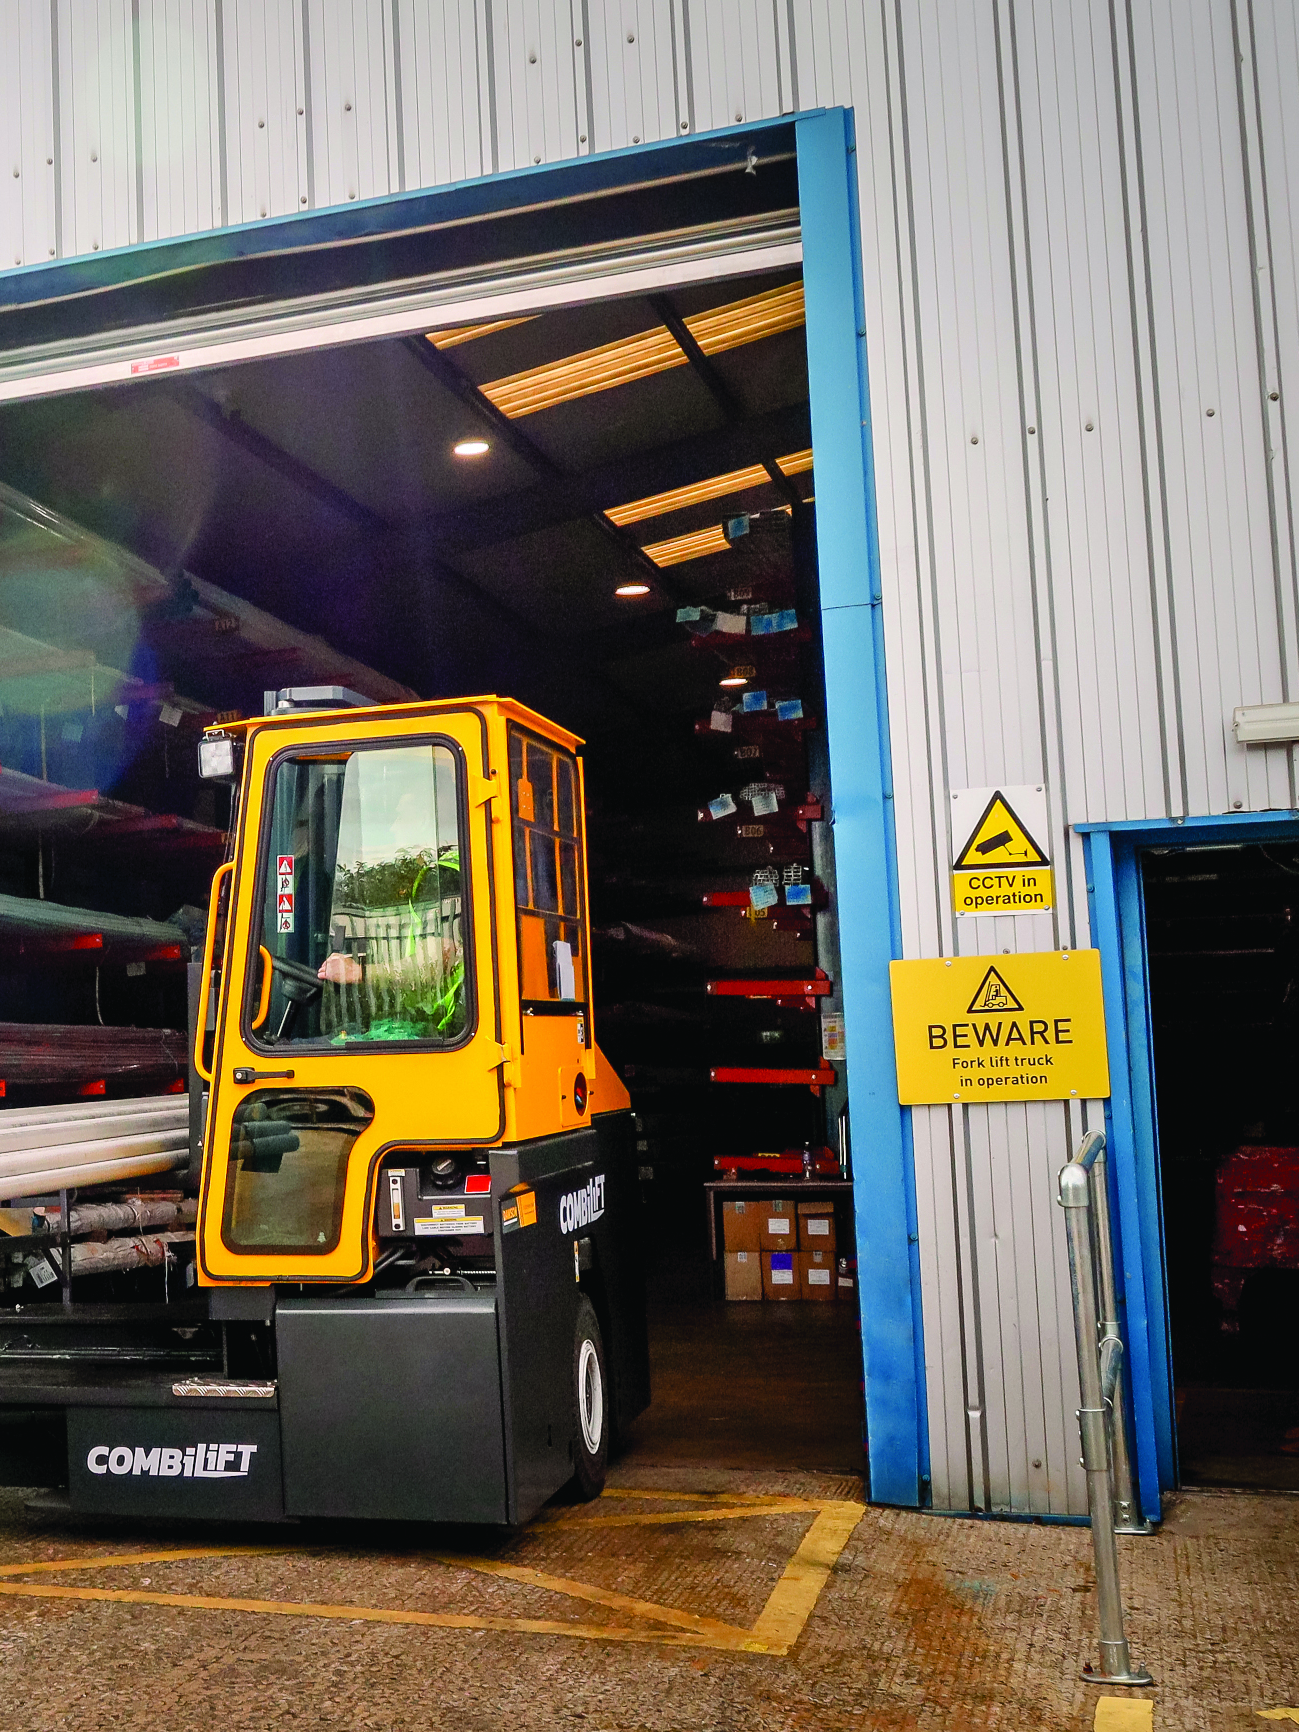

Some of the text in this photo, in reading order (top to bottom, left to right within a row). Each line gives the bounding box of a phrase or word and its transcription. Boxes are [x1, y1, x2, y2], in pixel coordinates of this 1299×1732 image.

[968, 874, 1037, 890] CCTV in
[963, 891, 1044, 909] operation
[927, 1018, 1074, 1050] BEWARE
[952, 1054, 1054, 1069] Fork lift truck
[959, 1073, 1048, 1089] in operation
